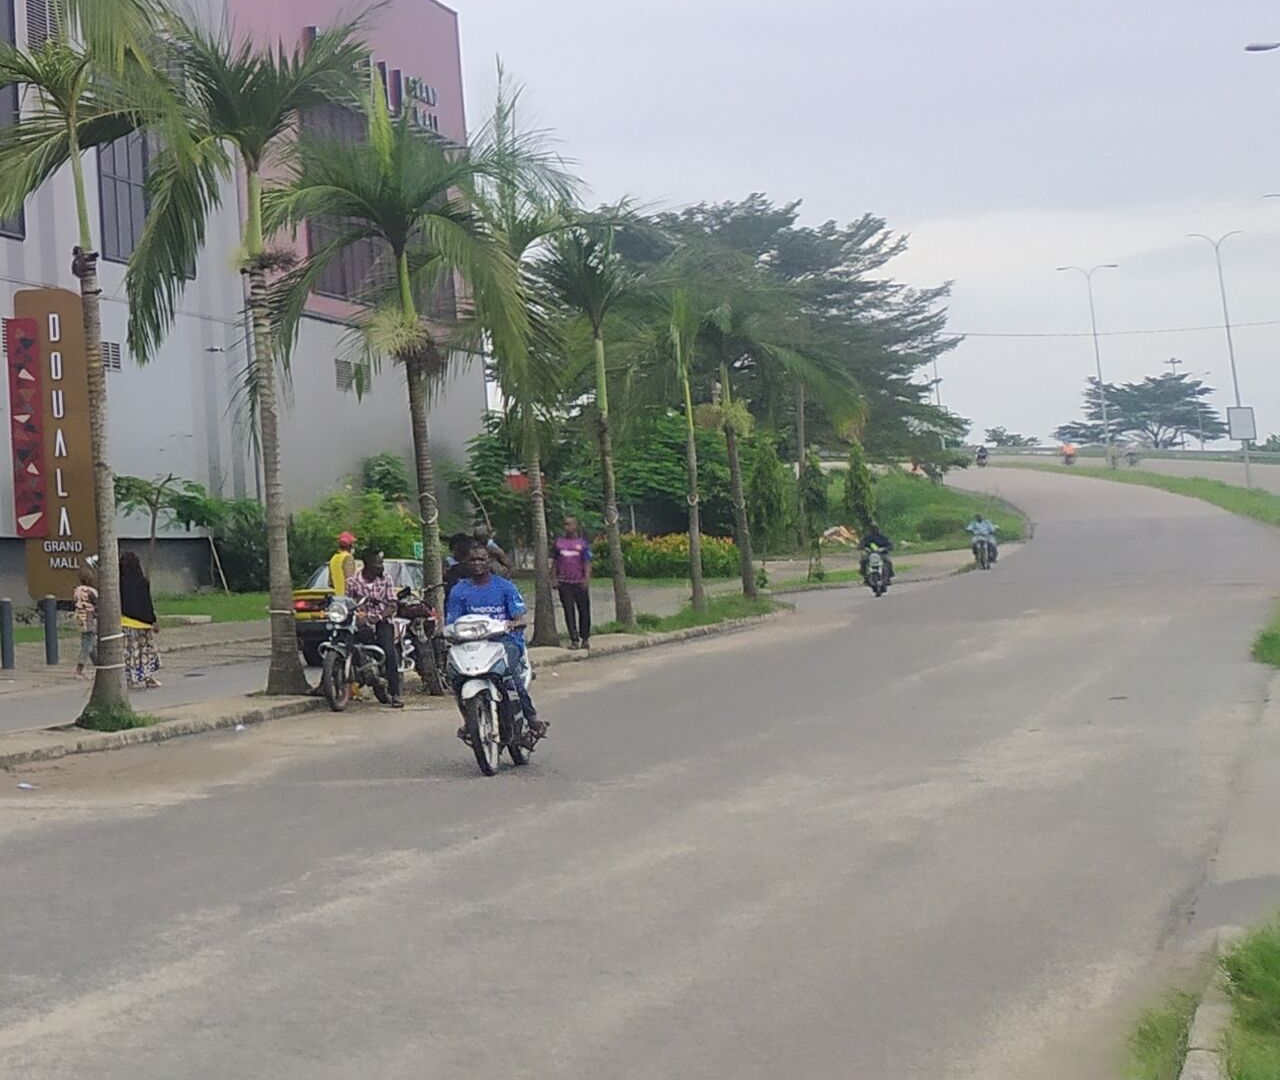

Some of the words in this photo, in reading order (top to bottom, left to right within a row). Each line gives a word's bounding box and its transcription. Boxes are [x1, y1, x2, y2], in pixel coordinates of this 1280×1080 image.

[48, 313, 72, 537] DOUALA
[43, 540, 83, 553] GRAND
[49, 556, 81, 569] MALL
